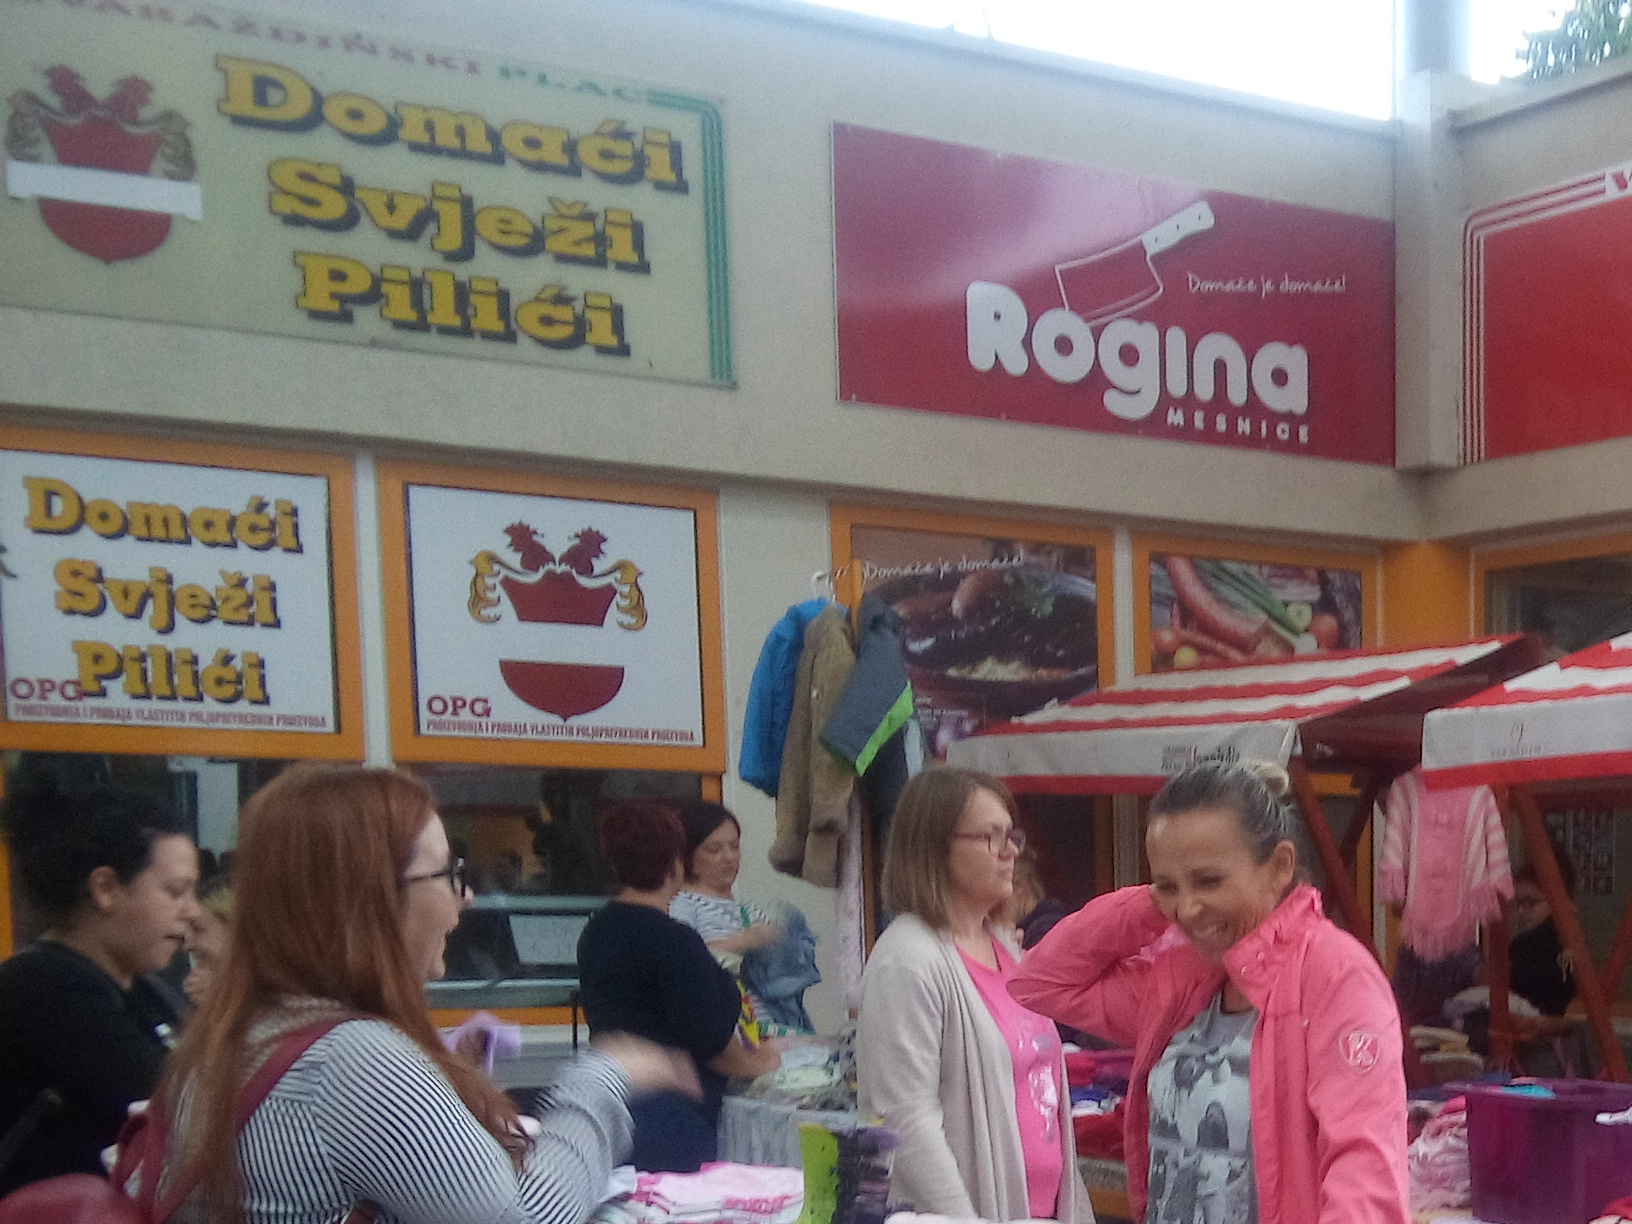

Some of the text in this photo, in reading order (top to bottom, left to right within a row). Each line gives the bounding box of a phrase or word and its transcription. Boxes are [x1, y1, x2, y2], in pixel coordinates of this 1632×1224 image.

[216, 54, 690, 194] Domaći
[268, 157, 650, 274] Svježi
[294, 251, 631, 357] Pilići
[1259, 274, 1274, 299] je
[965, 280, 1309, 420] Rogina
[1166, 405, 1309, 444] MESNICE
[23, 476, 303, 554] Domaći
[53, 557, 282, 633] Svježi
[9, 677, 84, 701] OPG
[71, 640, 270, 706] Pilići
[426, 695, 492, 718] OPG
